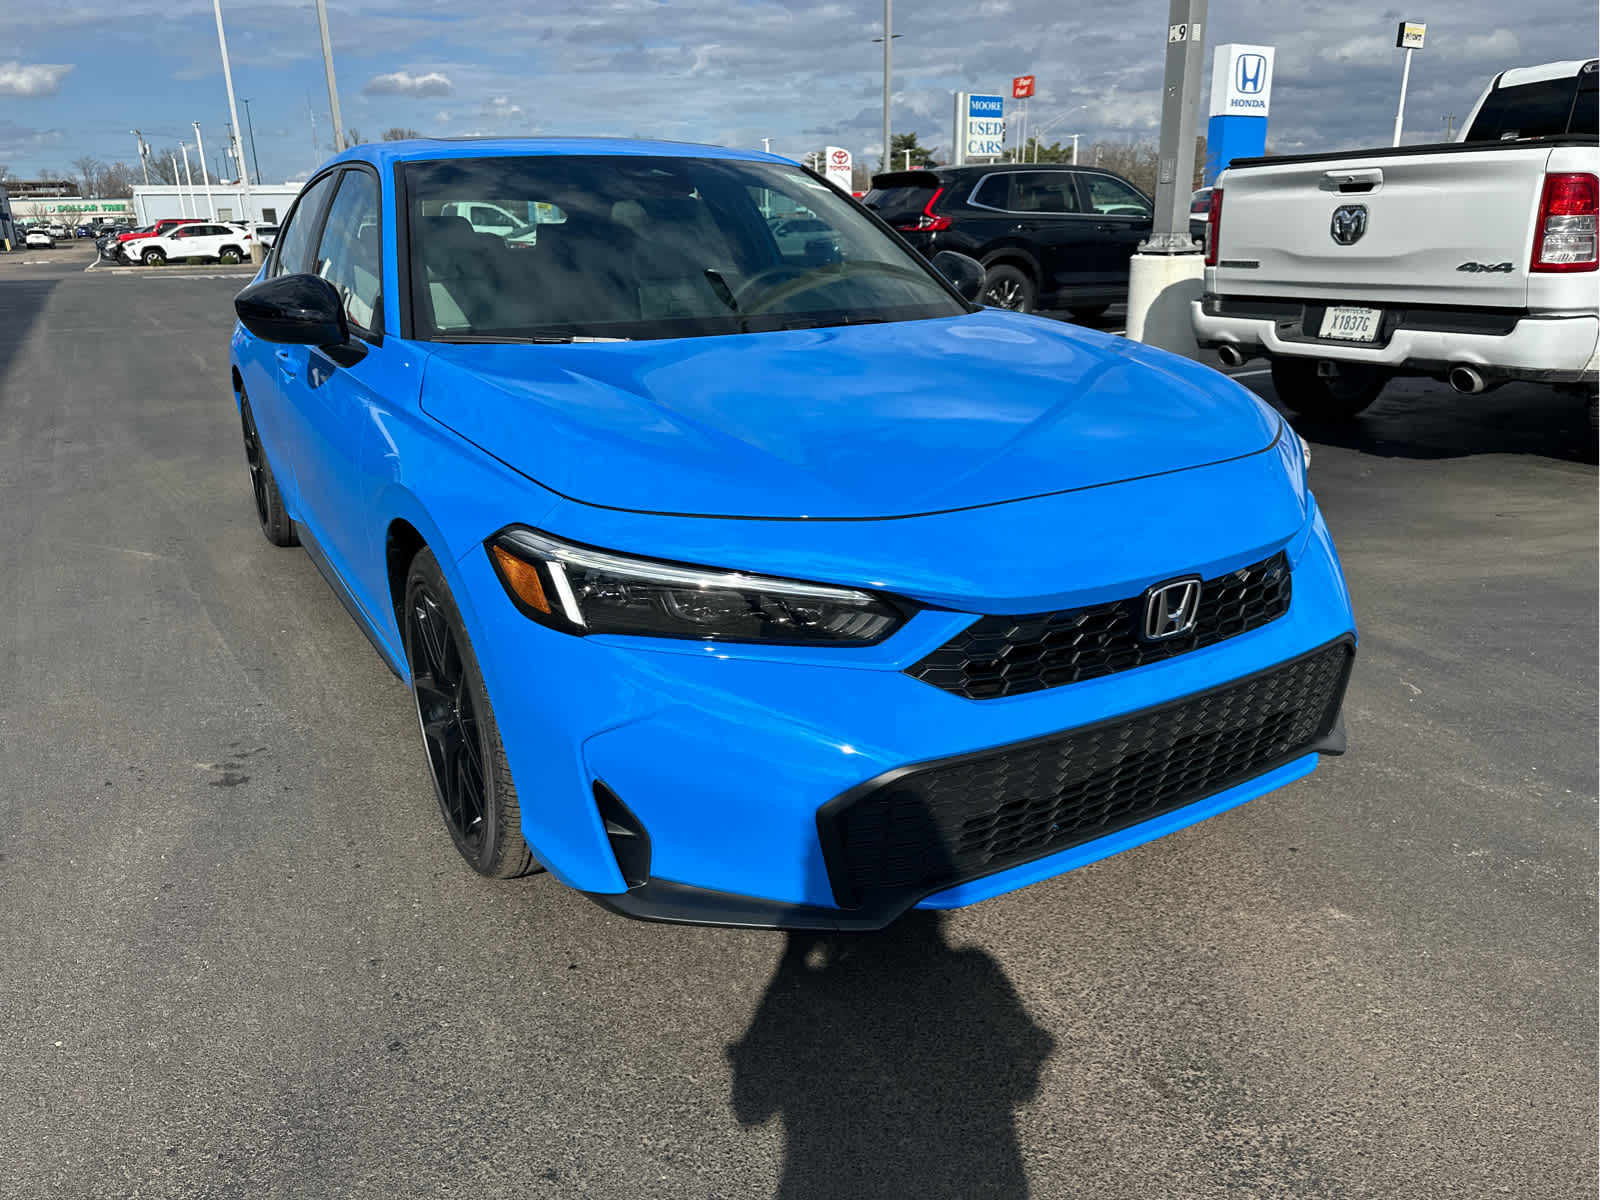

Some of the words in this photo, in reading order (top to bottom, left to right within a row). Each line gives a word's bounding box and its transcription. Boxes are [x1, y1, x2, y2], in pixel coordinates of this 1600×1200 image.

[1179, 25, 1186, 40] 9
[971, 101, 1001, 110] MOORE
[1230, 98, 1266, 108] HONDA
[969, 121, 1002, 135] USED
[968, 140, 1002, 153] CARS
[57, 204, 98, 212] DOLLAR
[1331, 314, 1370, 332] X1837G
